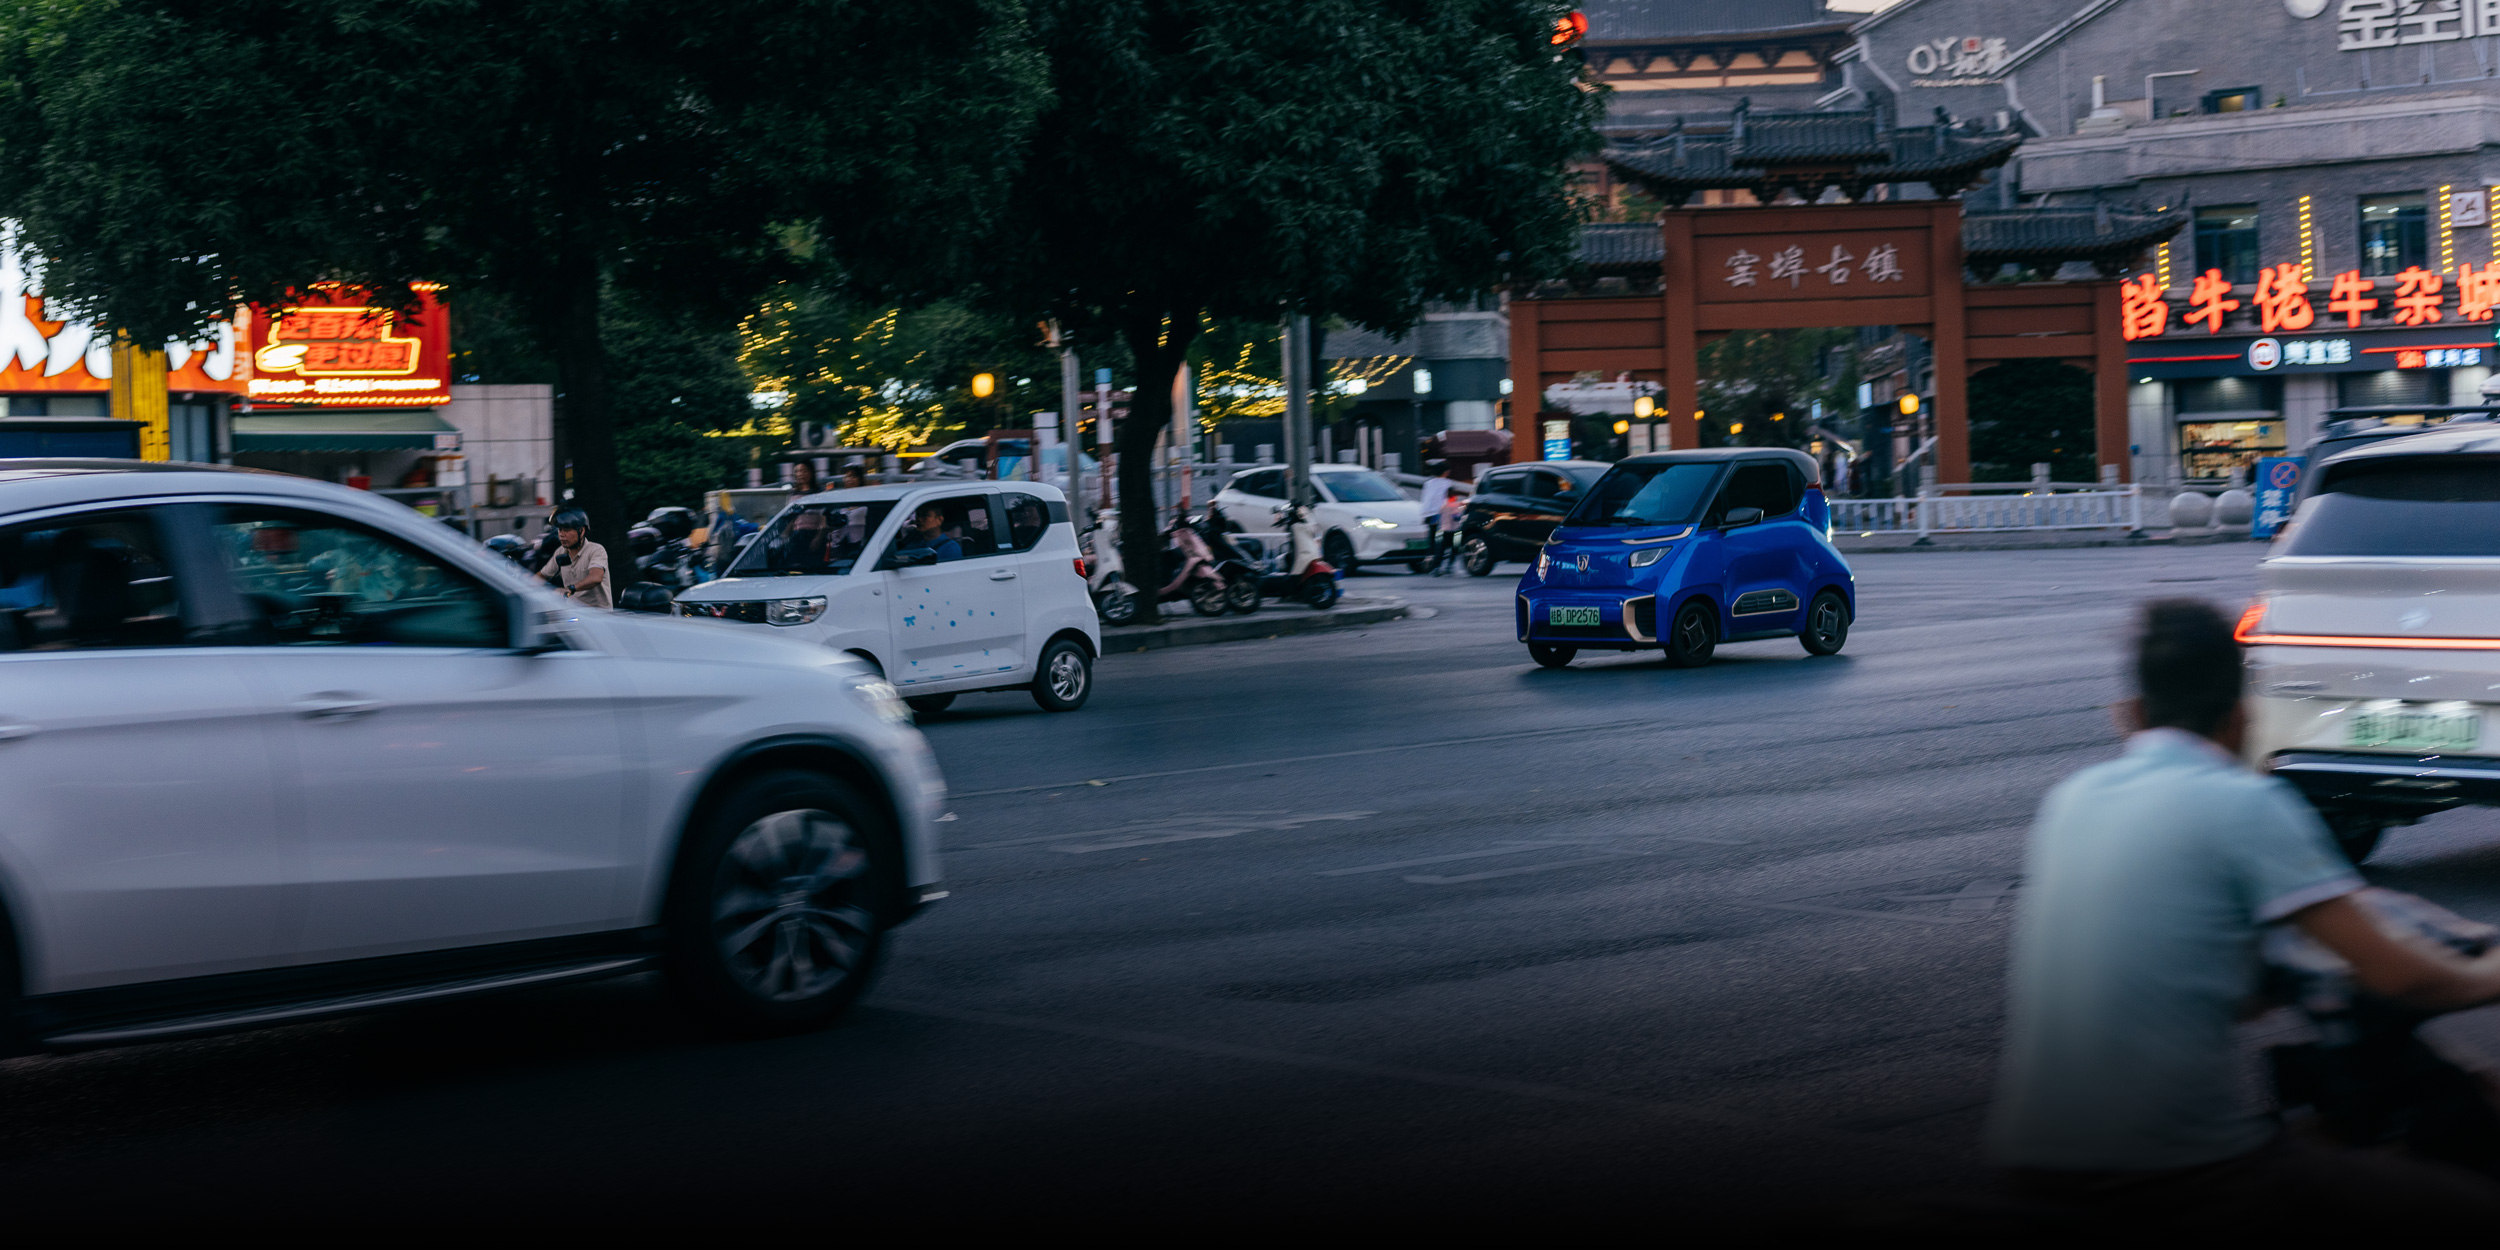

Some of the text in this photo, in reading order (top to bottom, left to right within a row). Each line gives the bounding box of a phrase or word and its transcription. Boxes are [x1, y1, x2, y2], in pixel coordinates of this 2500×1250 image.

[1723, 243, 1904, 290] 窑埠古镇
[1566, 609, 1599, 623] DP2576
